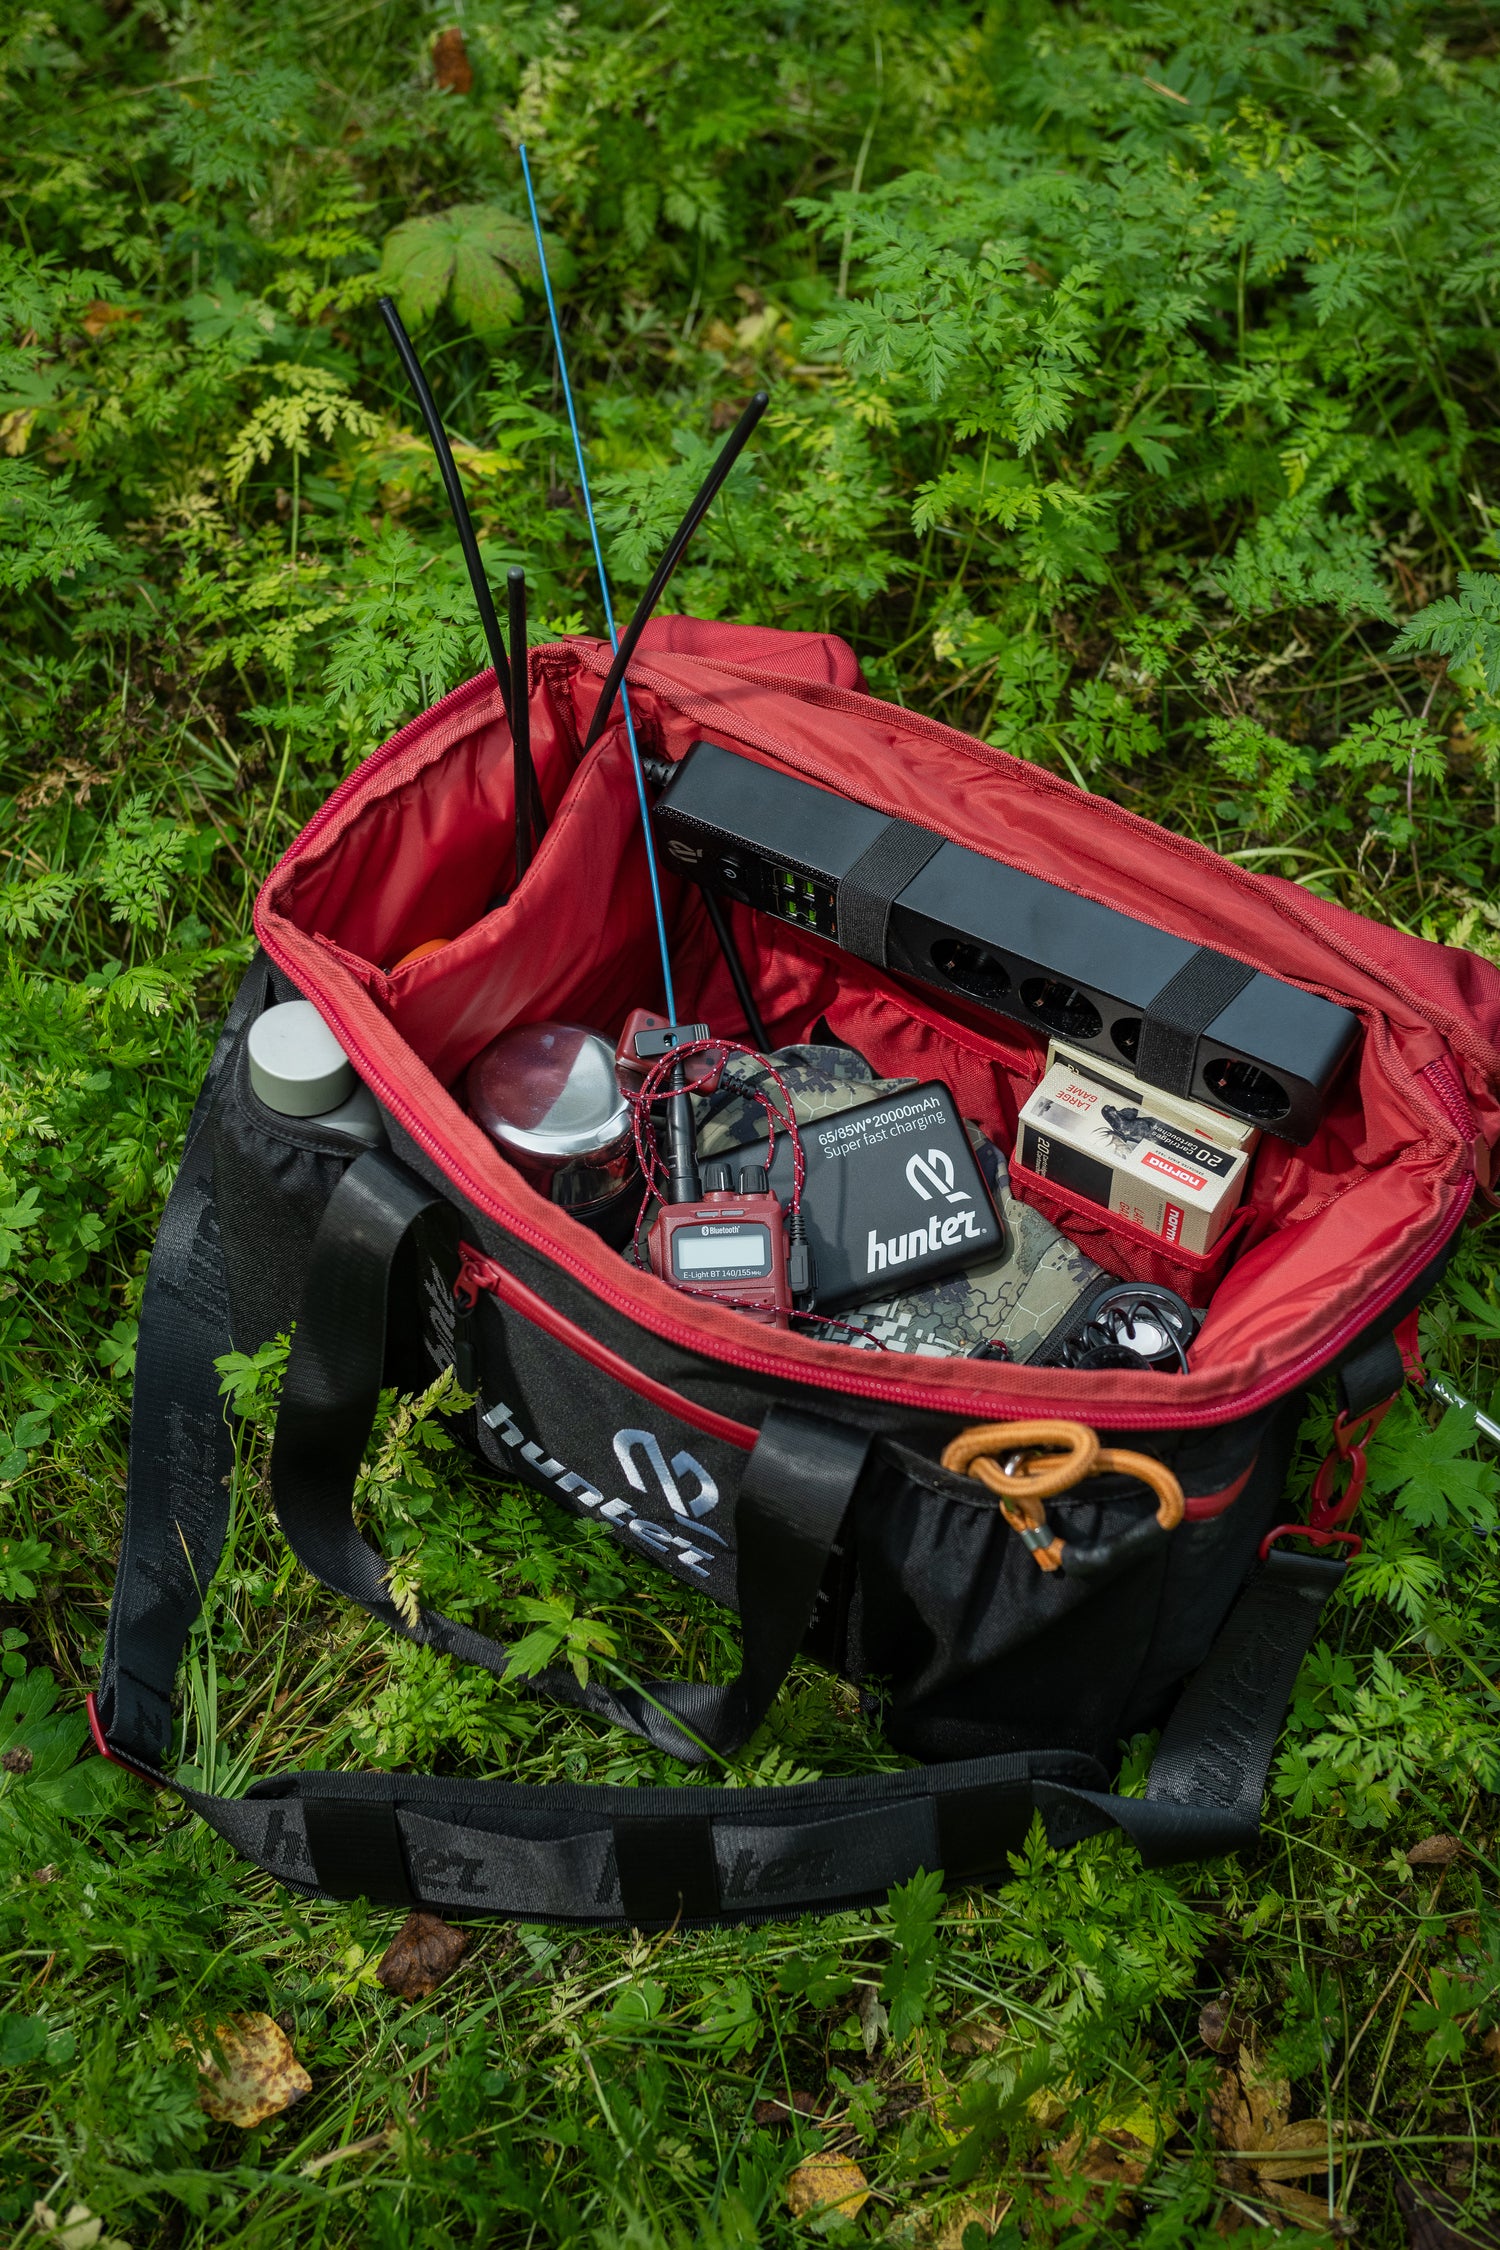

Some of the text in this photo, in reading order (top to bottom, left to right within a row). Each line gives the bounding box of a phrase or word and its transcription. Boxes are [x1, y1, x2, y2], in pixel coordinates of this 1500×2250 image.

[1055, 1090, 1092, 1112] LARGE
[1065, 1084, 1098, 1104] GAME
[823, 1110, 946, 1159] Super fast charging
[1037, 1136, 1051, 1156] 20
[1152, 1131, 1195, 1156] Cartridges
[1195, 1148, 1224, 1168] 20
[1148, 1156, 1201, 1187] norma
[709, 1226, 741, 1235] Bluetooth
[1165, 1208, 1181, 1243] norm
[866, 1210, 982, 1274] hunter
[683, 1270, 709, 1280] E-Light
[710, 1270, 721, 1278] BT
[722, 1269, 751, 1278] 140/155
[481, 1401, 716, 1579] hunter
